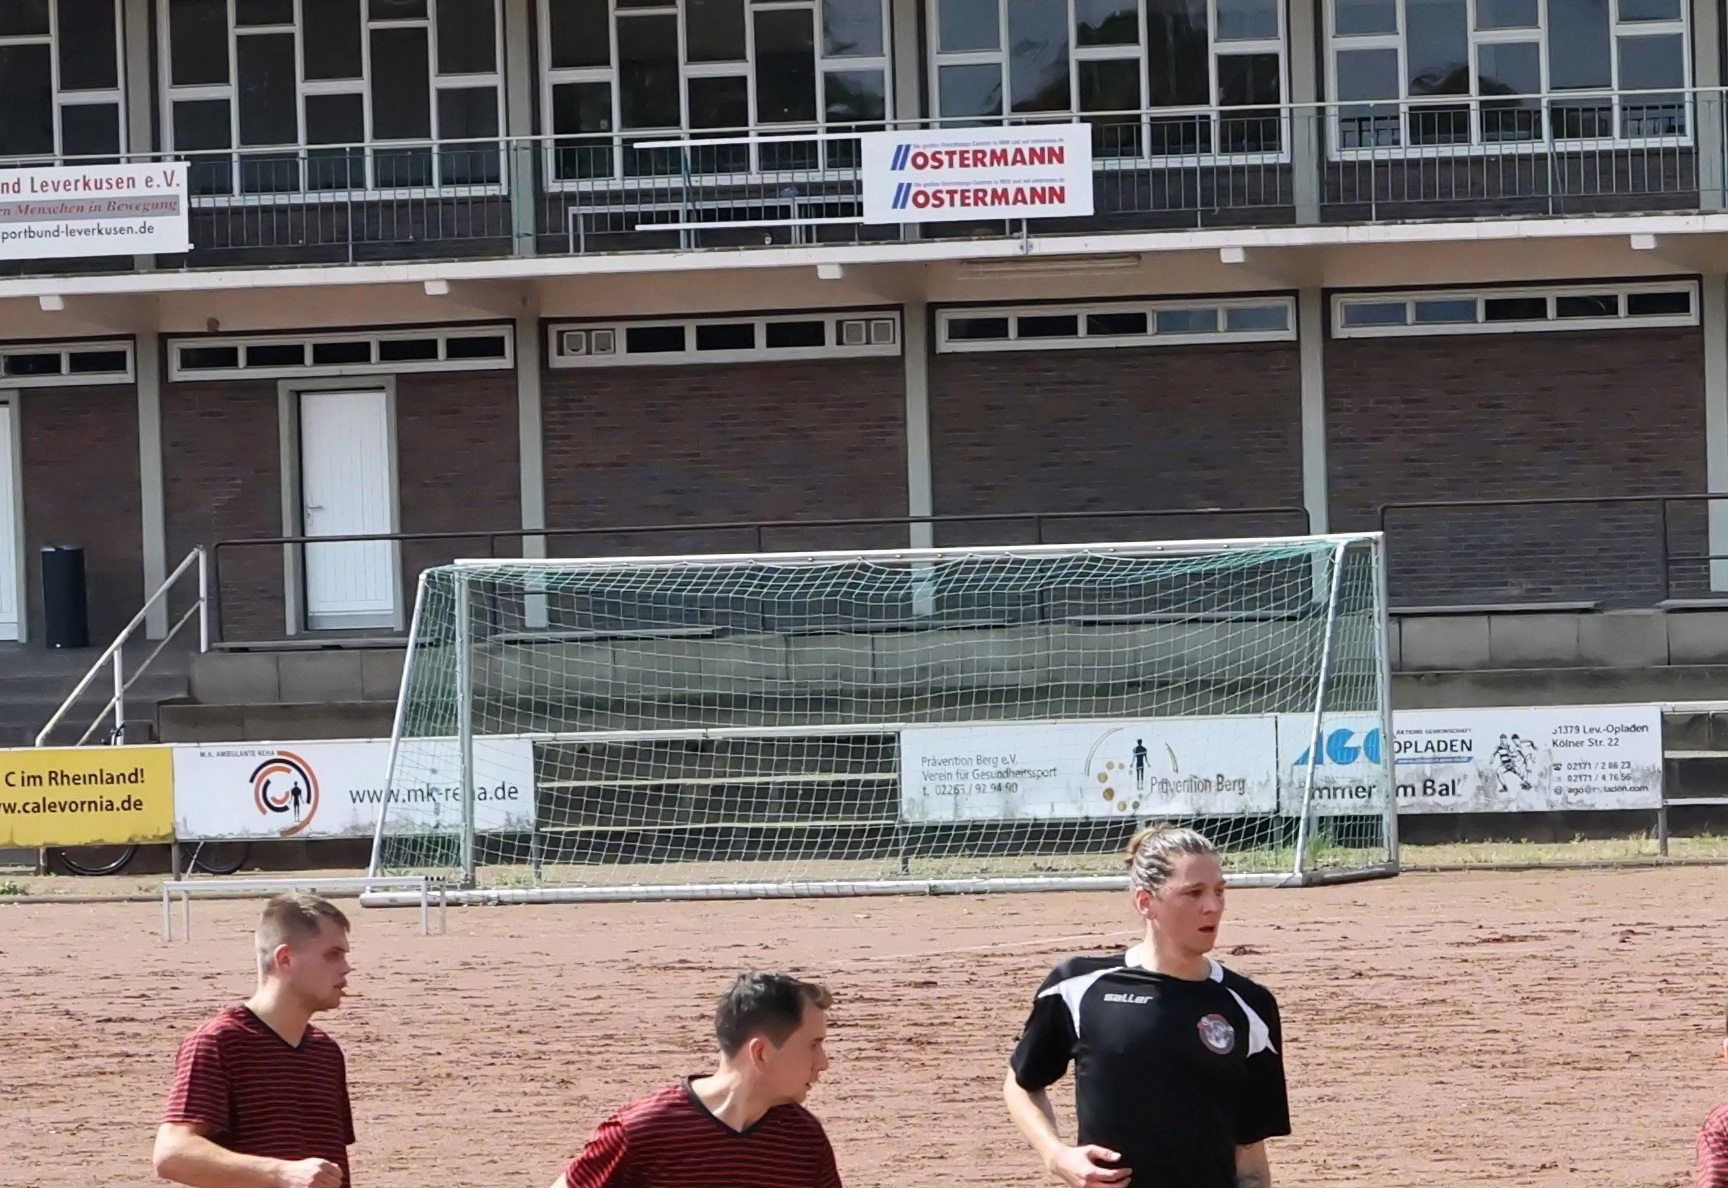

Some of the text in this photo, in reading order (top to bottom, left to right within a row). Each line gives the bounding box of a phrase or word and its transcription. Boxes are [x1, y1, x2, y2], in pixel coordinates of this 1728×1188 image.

[911, 146, 1064, 170] OSTERMANN
[30, 175, 136, 193] Leverkusen
[144, 170, 180, 189] e.V.
[911, 186, 1066, 209] OSTERMANN
[17, 202, 84, 216] Menschen
[89, 201, 101, 212] in
[106, 198, 177, 212] Bewegung
[1, 221, 155, 243] portbund-leverkusen.de
[1582, 724, 1649, 735] Lev.-Opladen
[1394, 739, 1473, 754] OPLADEN
[1552, 739, 1585, 748] Kölner
[1607, 737, 1620, 746] 22
[976, 754, 998, 767] Berg
[1621, 761, 1631, 769] 23
[5, 767, 145, 787] C im Rheinland!
[922, 770, 953, 781] Verein
[956, 769, 969, 780] für
[1216, 773, 1246, 795] Berg
[349, 781, 518, 803] www.mk-rea.de
[1311, 784, 1375, 799] mmer
[1394, 784, 1416, 797] m
